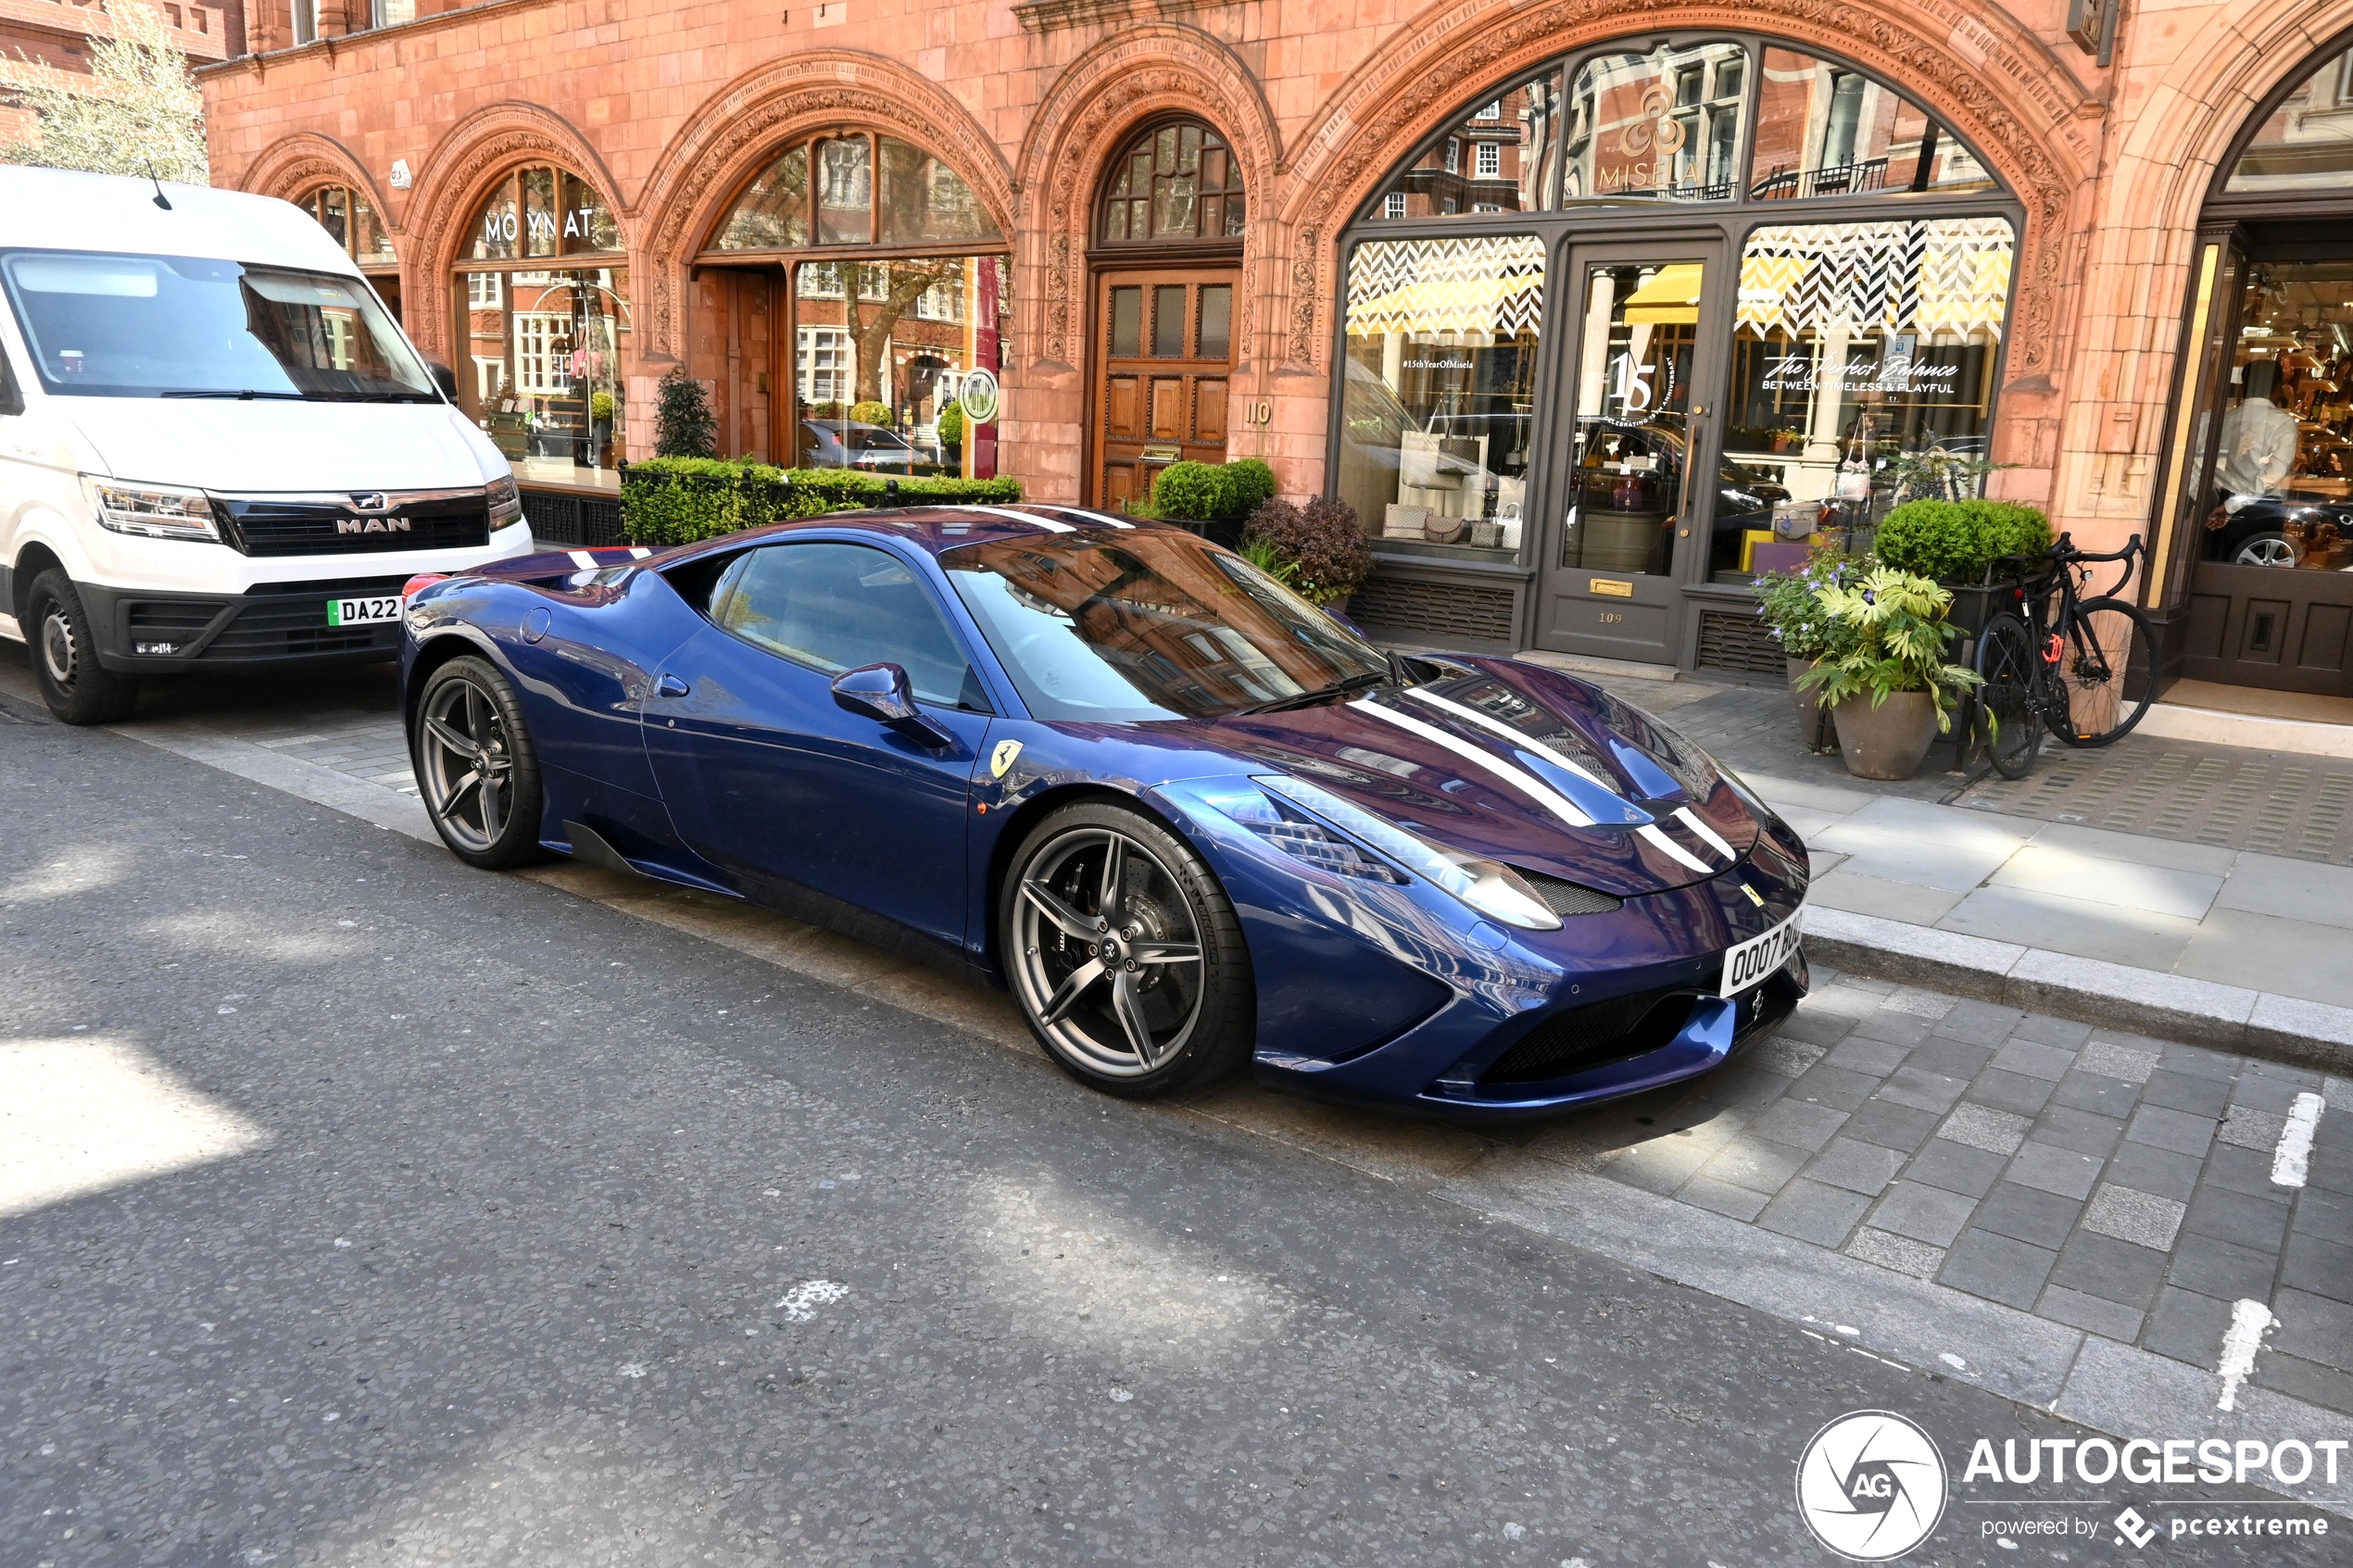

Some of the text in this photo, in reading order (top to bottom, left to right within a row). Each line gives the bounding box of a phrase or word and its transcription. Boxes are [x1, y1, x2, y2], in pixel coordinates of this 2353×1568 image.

[1599, 162, 1698, 189] MISELA
[485, 208, 593, 243] MOYNAT
[1403, 359, 1473, 369] #15thYearOfMisela
[1764, 353, 1808, 379] The
[1805, 351, 1878, 382] Perfect
[1877, 356, 1958, 382] Balance
[1604, 415, 1648, 427] CELEBRATING
[1662, 357, 1675, 407] ANNIVERSARY
[1609, 351, 1655, 411] 15
[1762, 381, 1955, 394] BETWEEN TIMELESS & PLAYFUL
[1246, 401, 1271, 424] 110
[336, 517, 411, 534] MAN
[342, 599, 397, 621] DA22
[1599, 612, 1623, 624] 109
